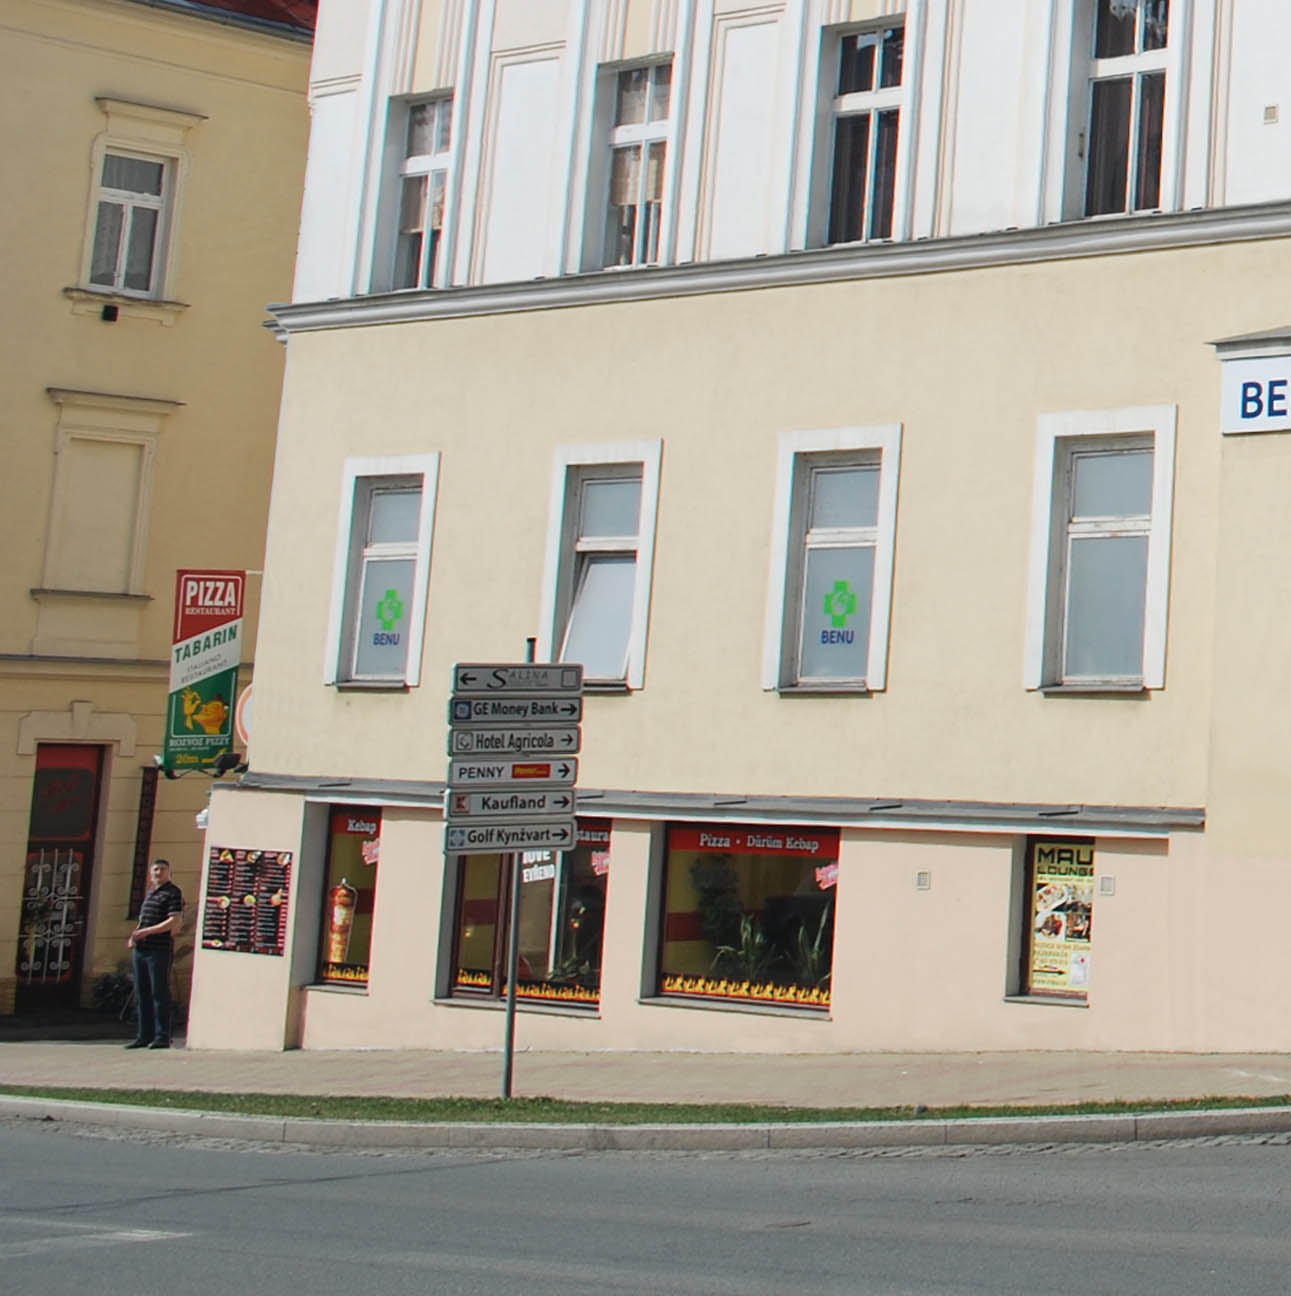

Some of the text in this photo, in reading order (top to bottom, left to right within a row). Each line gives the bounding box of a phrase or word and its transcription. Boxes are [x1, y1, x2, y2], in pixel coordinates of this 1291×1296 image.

[186, 581, 236, 606] PIZZA
[185, 607, 236, 615] RESTAURANT
[174, 625, 238, 664] TABARIN
[373, 632, 400, 645] BENU
[821, 630, 855, 644] BENU
[473, 701, 559, 717] GE Money Bank
[476, 733, 554, 752] Hotel Agricola
[458, 766, 504, 779] PENNY
[482, 795, 546, 810] Kaufland
[347, 819, 377, 834] Kebap
[467, 827, 550, 846] Golf Kynžvart
[700, 833, 819, 853] Pizza Dürüm Kebap
